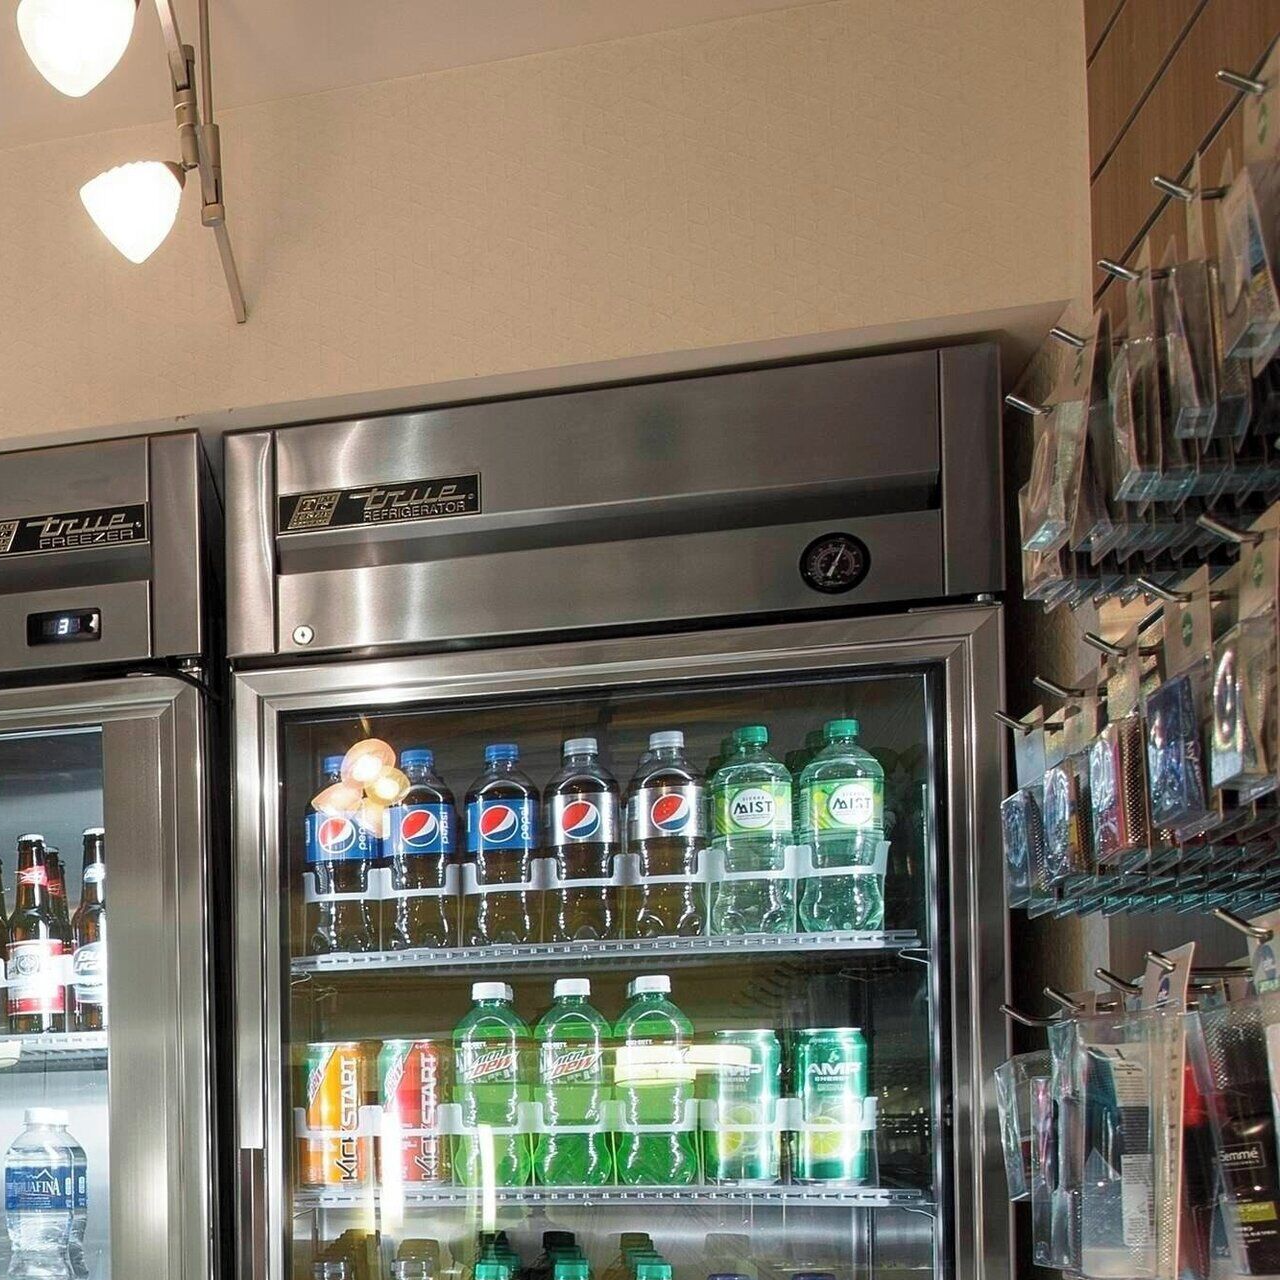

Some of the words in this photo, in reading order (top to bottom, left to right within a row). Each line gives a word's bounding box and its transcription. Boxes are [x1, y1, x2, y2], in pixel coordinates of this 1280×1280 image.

[349, 484, 466, 510] true
[363, 500, 466, 522] REFRIGERATOR
[26, 513, 134, 538] true
[38, 529, 134, 549] FREEZER
[57, 618, 70, 635] 3
[733, 800, 773, 815] MIST
[832, 797, 872, 810] MIST
